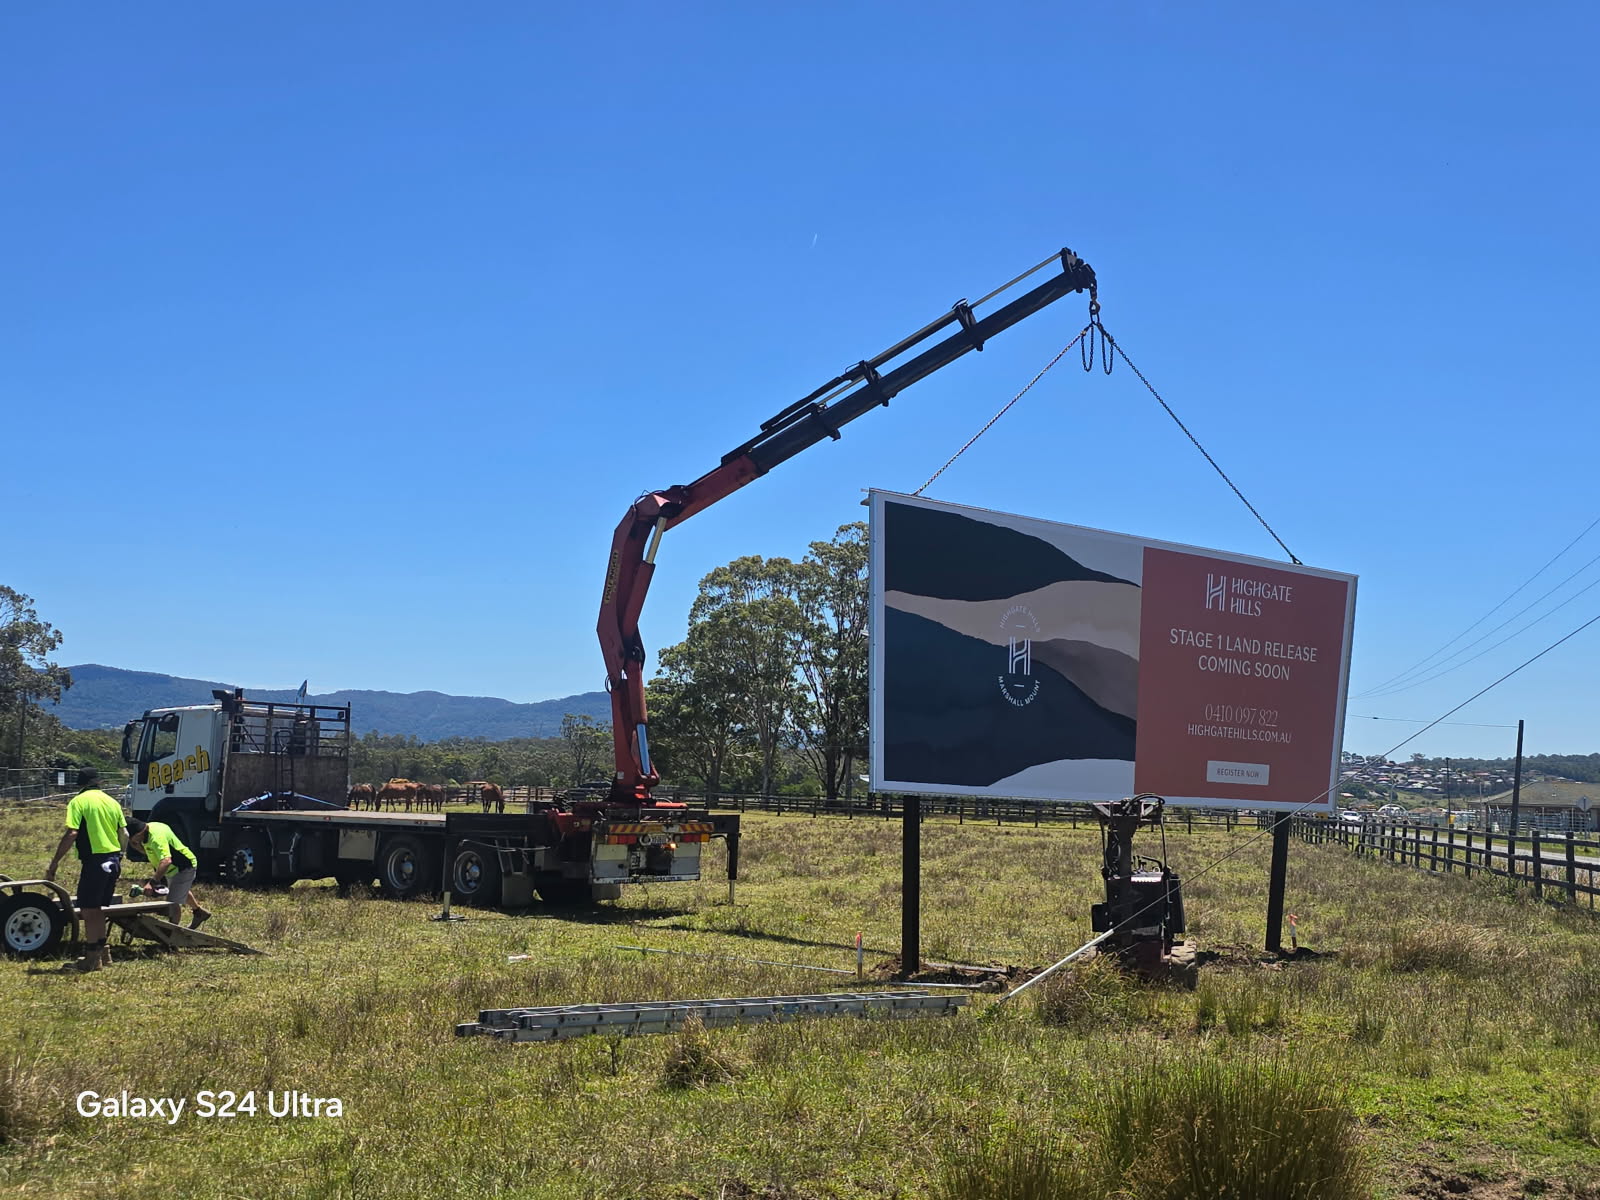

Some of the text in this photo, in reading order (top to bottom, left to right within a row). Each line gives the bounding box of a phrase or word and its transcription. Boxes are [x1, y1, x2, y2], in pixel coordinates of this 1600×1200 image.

[1232, 578, 1292, 603] HIGHGATE
[1230, 597, 1262, 616] HILLS
[1170, 628, 1318, 662] STAGE 1 LAND RELEASE
[1198, 655, 1290, 680] COMING SOON
[1024, 680, 1040, 704] MOUNT
[1205, 703, 1279, 727] 0410 097 822
[1187, 724, 1292, 744] HIGHGATEHILLS.COM.AU
[148, 744, 210, 792] Reach
[1216, 767, 1260, 778] REGISTER NOW
